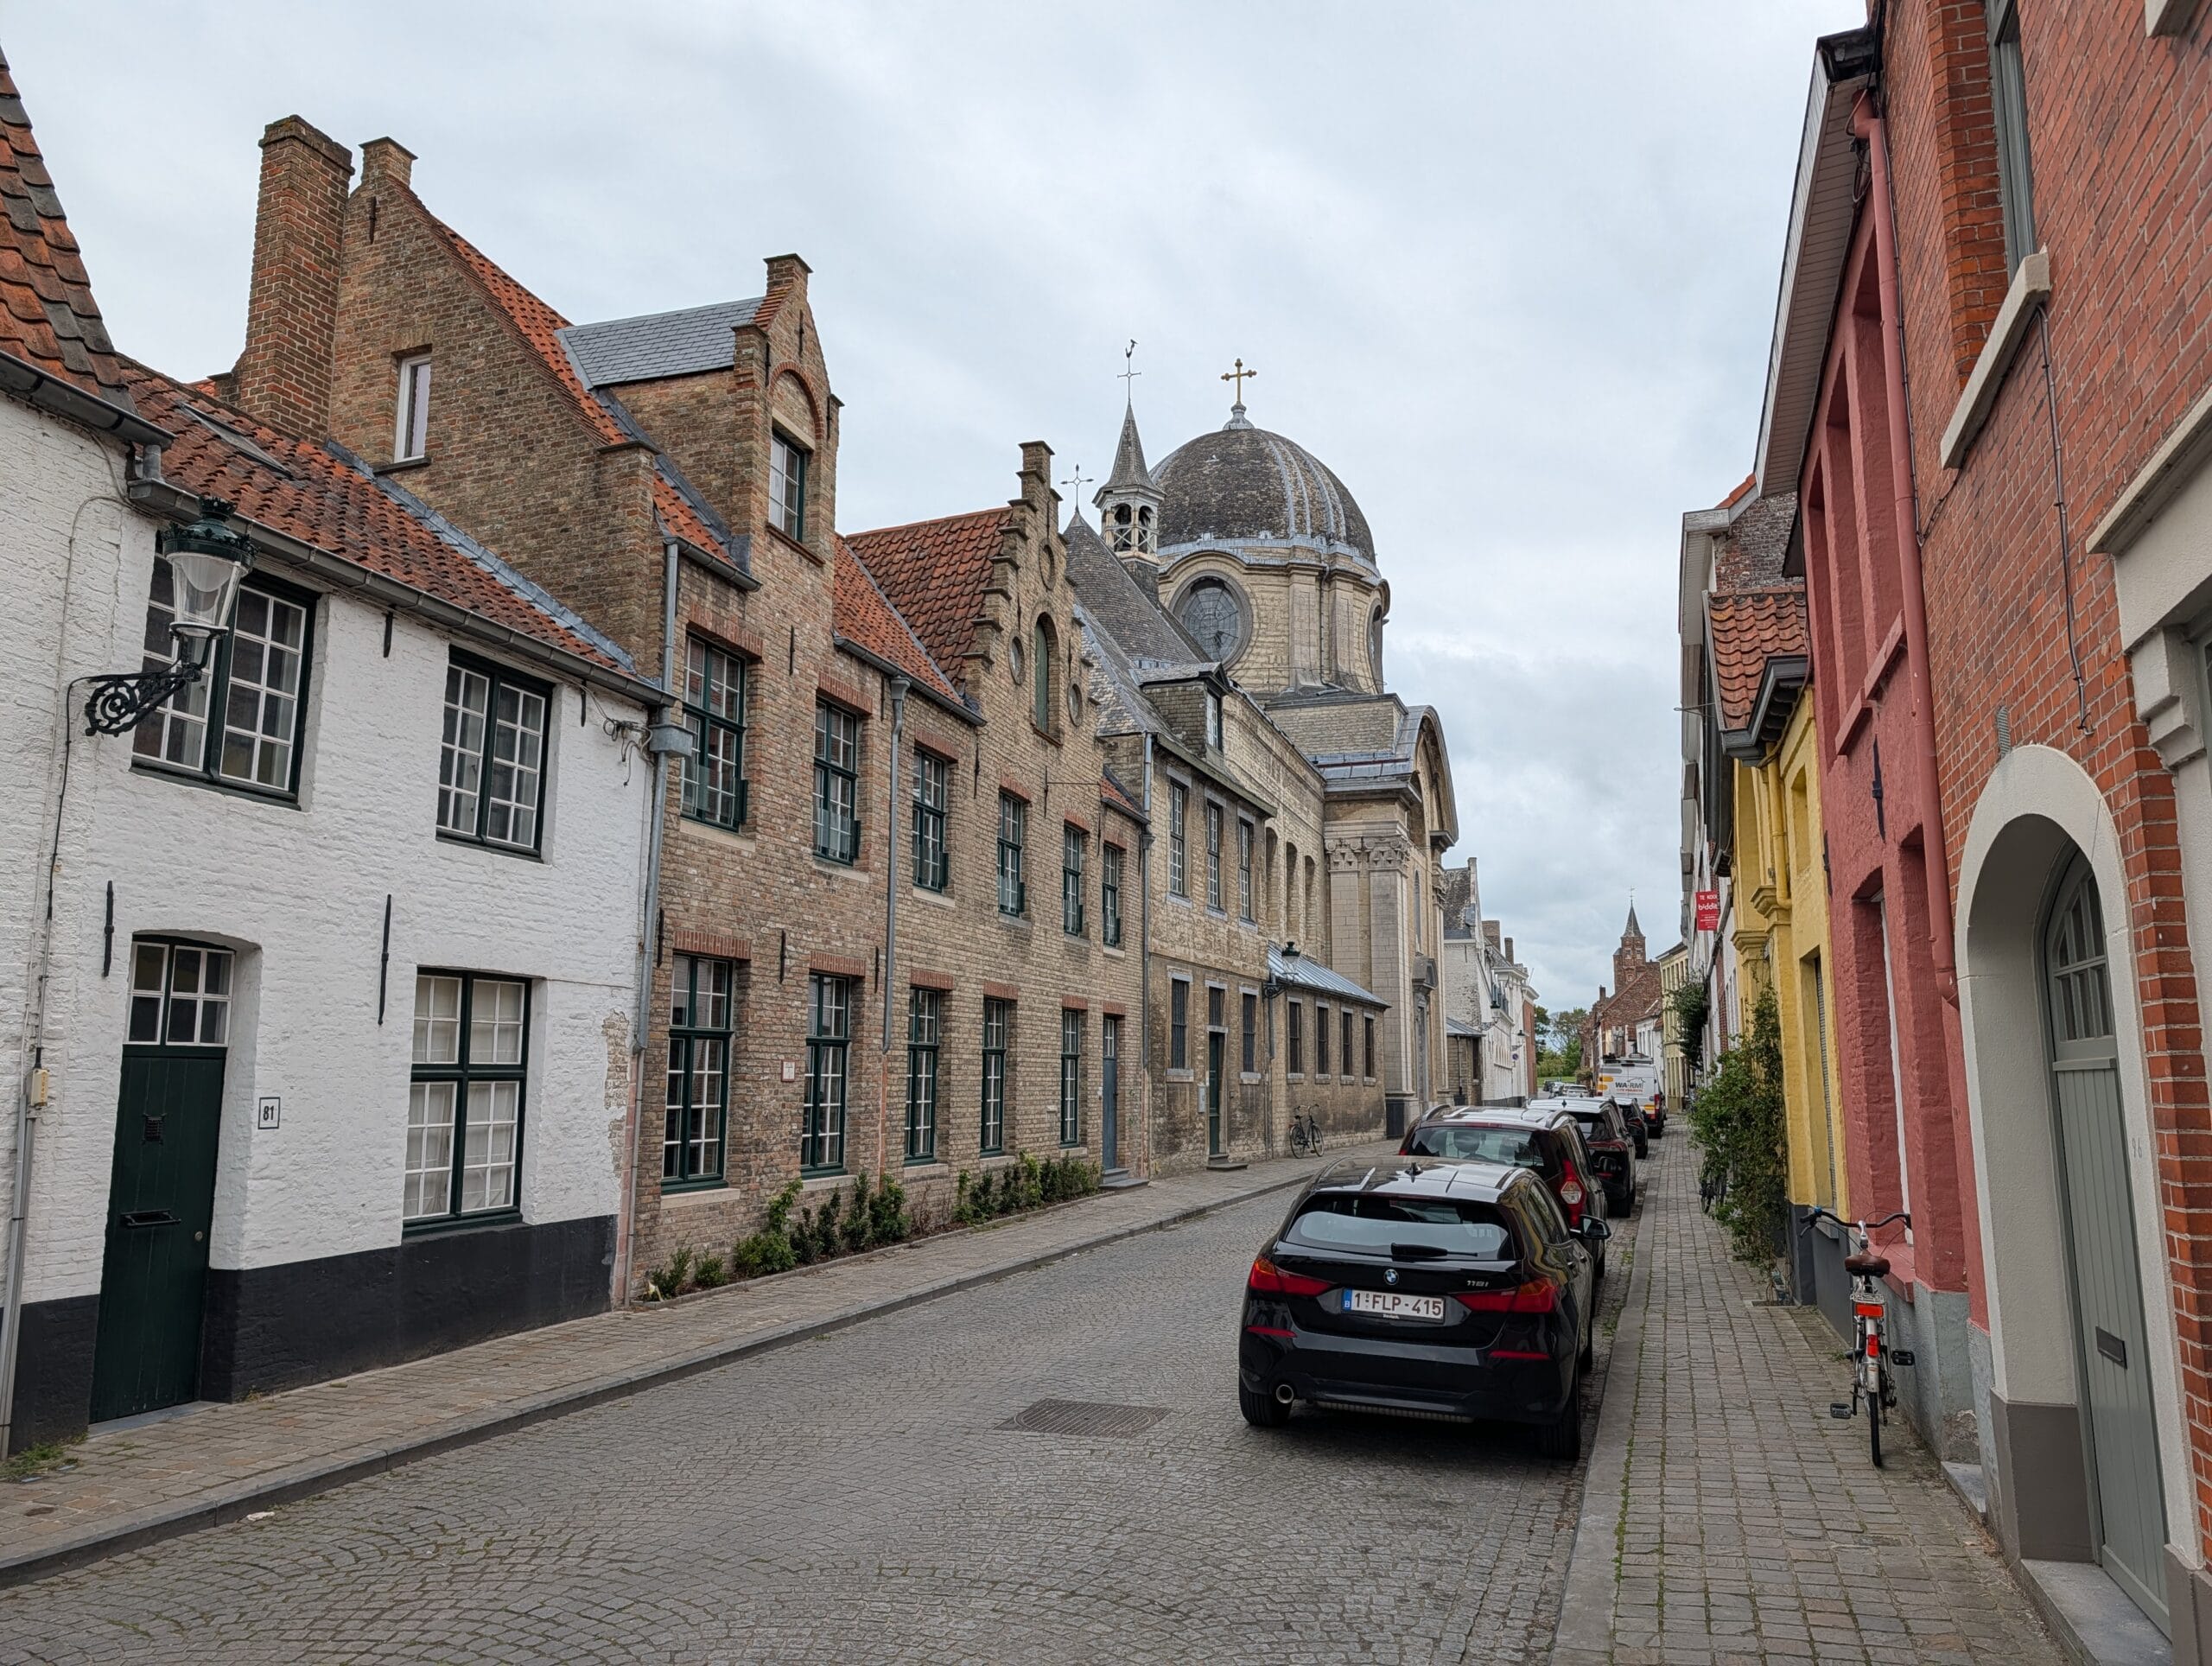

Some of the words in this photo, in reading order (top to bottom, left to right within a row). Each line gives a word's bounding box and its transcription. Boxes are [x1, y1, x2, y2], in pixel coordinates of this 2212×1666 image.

[263, 1106, 275, 1121] 81
[2132, 1137, 2143, 1158] 96
[1355, 1293, 1442, 1316] 1-FLP-415
